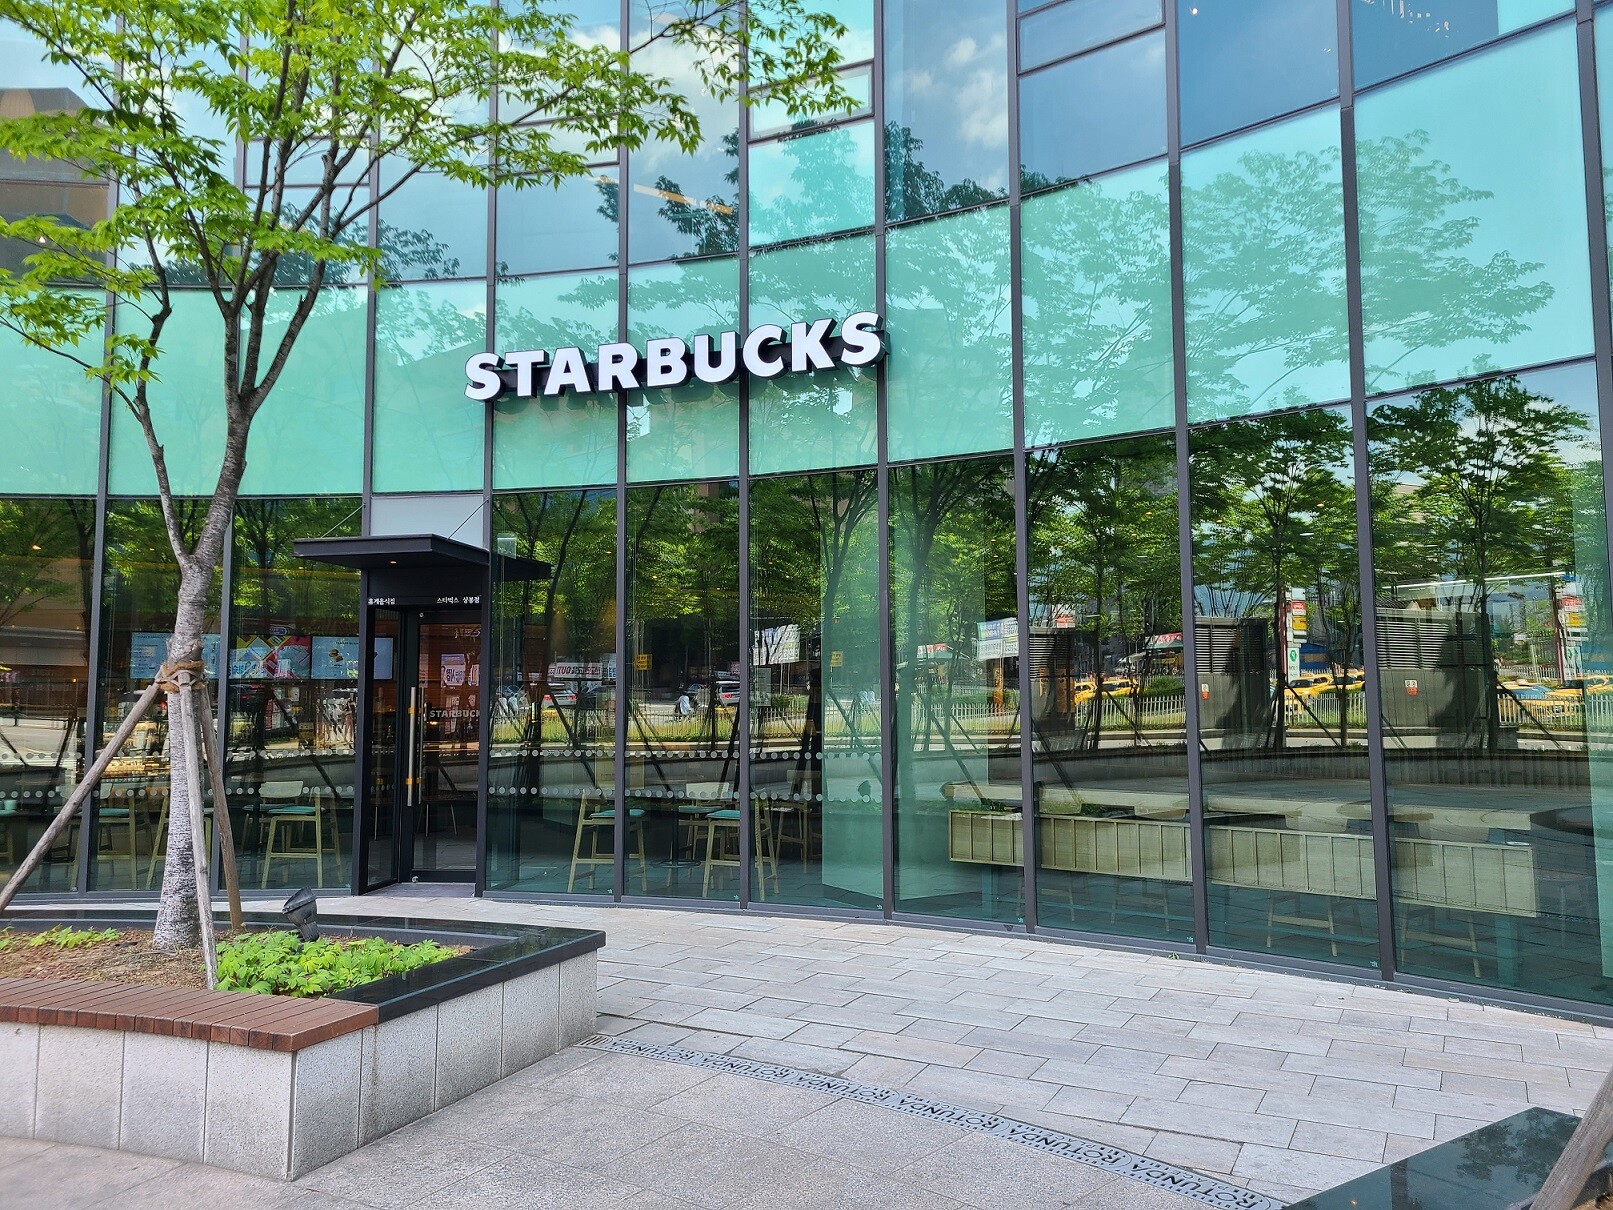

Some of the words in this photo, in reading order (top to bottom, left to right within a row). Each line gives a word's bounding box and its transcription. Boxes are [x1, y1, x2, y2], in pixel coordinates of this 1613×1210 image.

[464, 311, 886, 402] STARBUCKS
[612, 1042, 695, 1060] ROTUNDA
[702, 1058, 790, 1078] ROTUNDA
[798, 1077, 890, 1101] ROTUNDA
[899, 1099, 999, 1129] ROTUNDA
[1009, 1128, 1121, 1164] ROTUNDA
[1131, 1163, 1259, 1208] ROTUNDA
